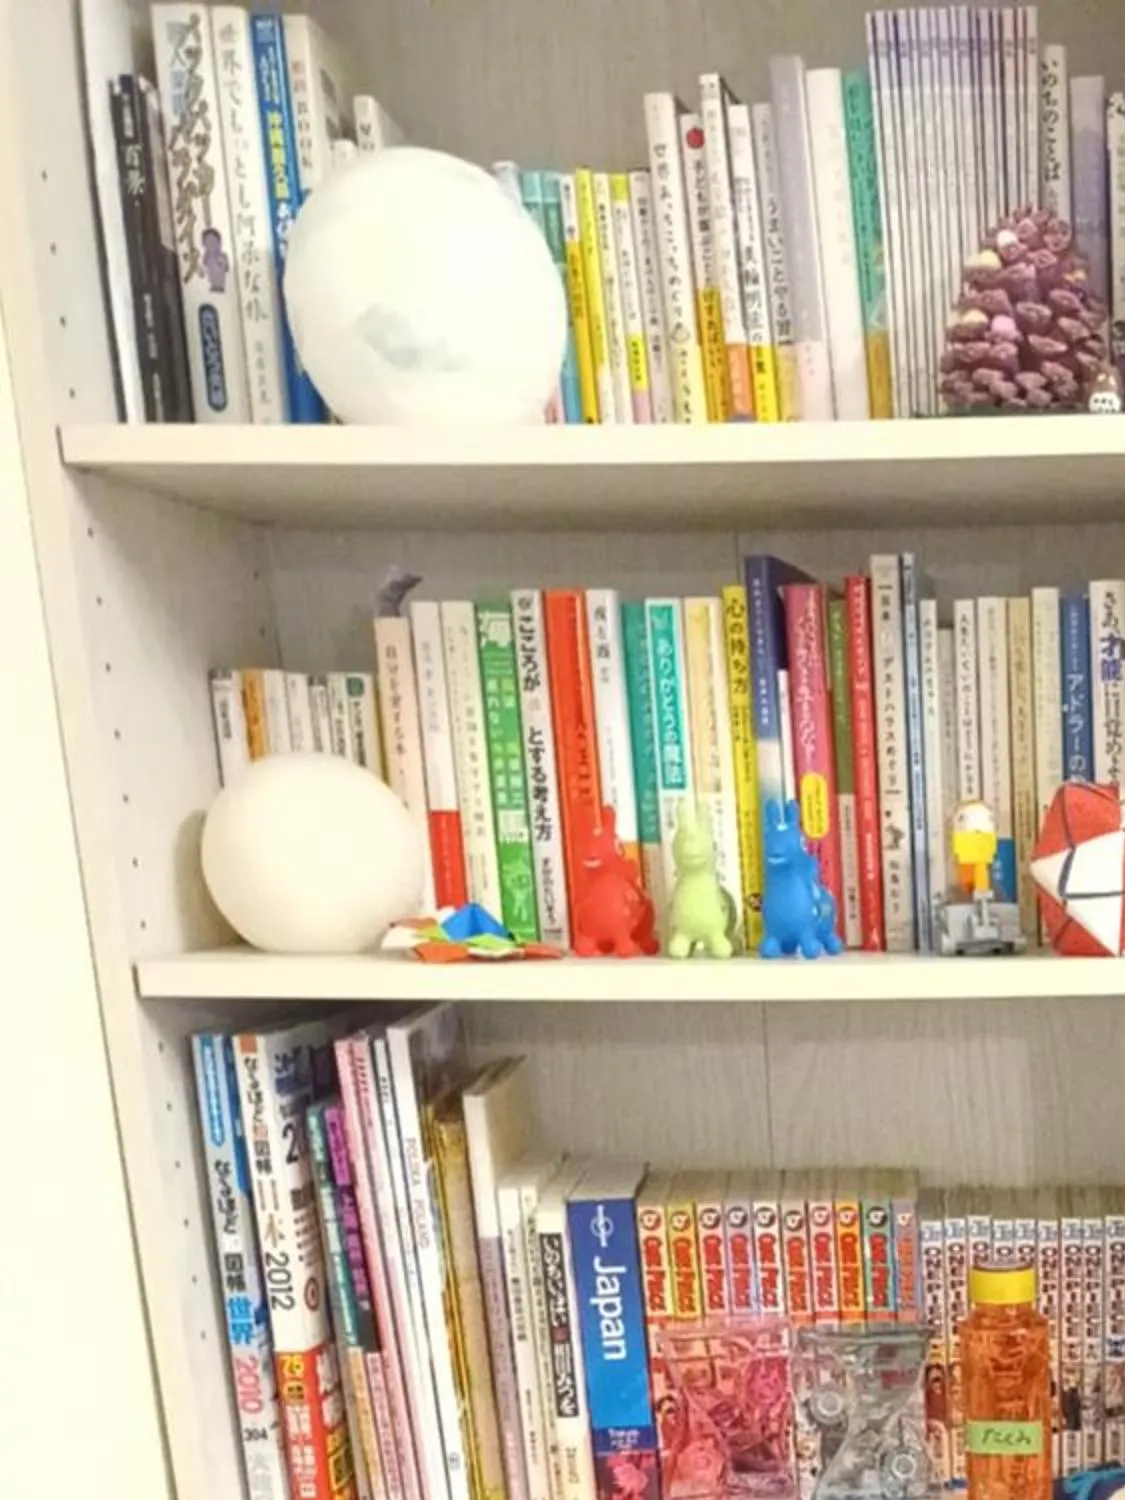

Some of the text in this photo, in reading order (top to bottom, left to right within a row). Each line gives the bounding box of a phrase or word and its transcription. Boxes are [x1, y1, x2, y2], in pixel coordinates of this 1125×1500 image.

[1065, 673, 1086, 783] アドラーの
[924, 1247, 941, 1280] ONE
[948, 1242, 964, 1277] ONE
[1042, 1247, 1057, 1280] ONE
[1065, 1245, 1081, 1337] ONE PIECE
[1085, 1246, 1101, 1338] ONE PIECE
[1110, 1242, 1125, 1334] ONE PIECE
[589, 1256, 628, 1361] Japan
